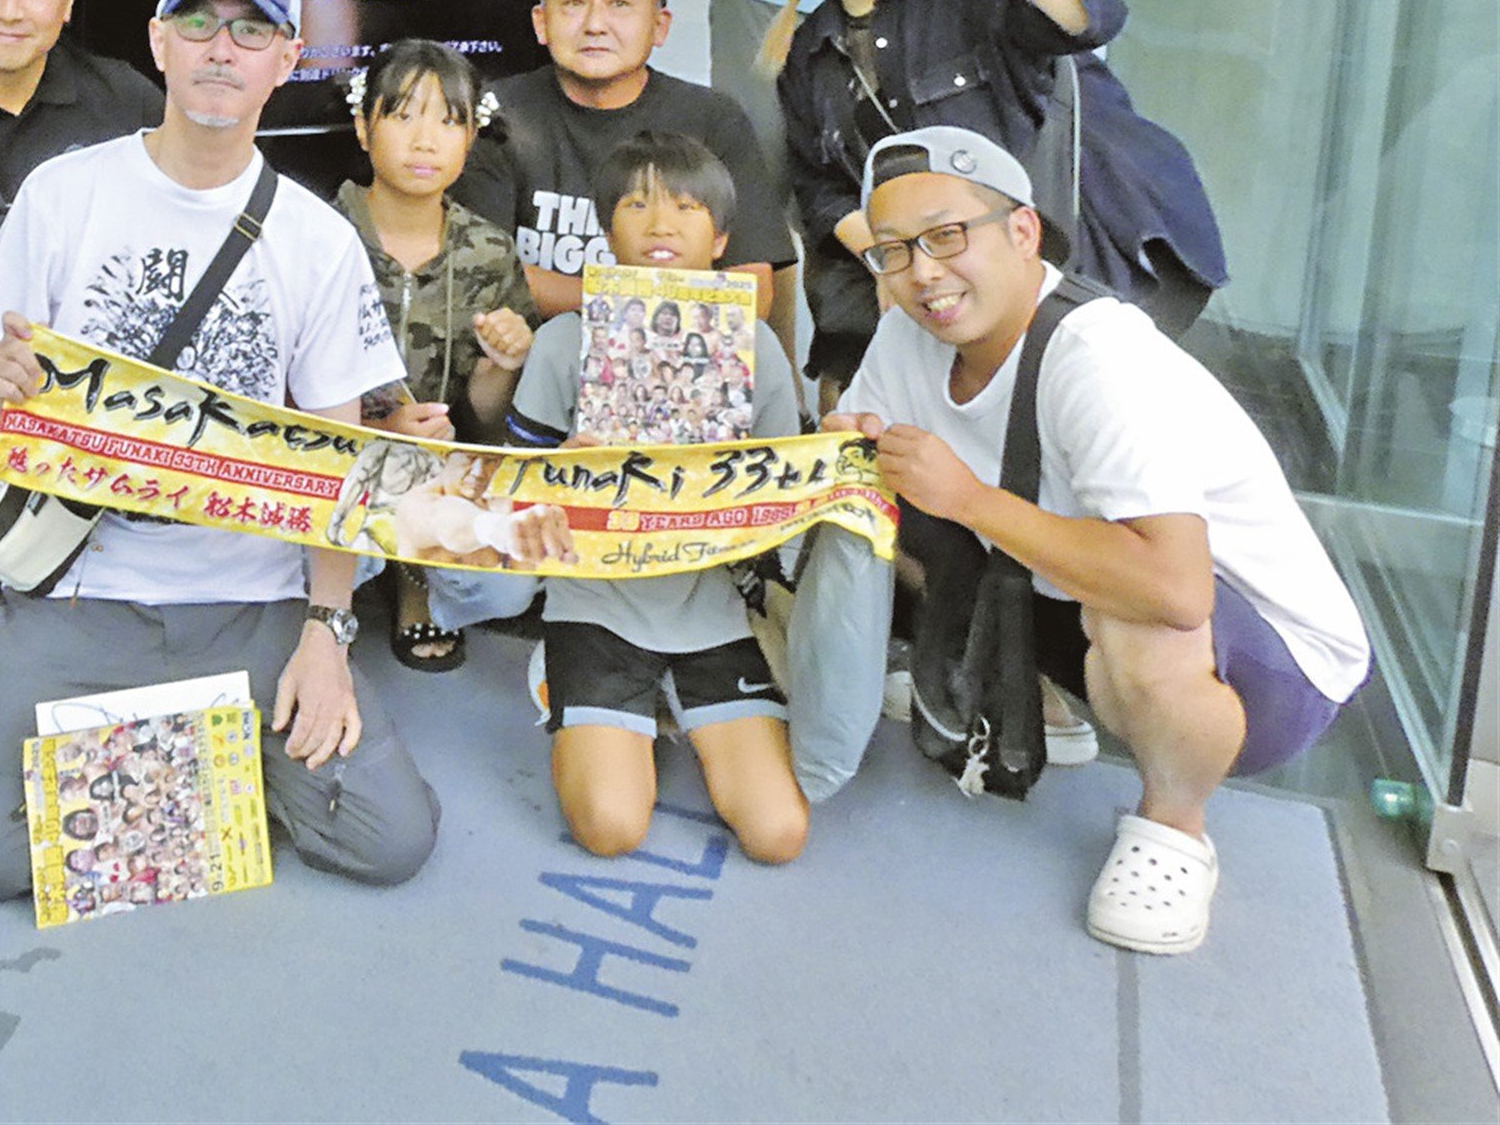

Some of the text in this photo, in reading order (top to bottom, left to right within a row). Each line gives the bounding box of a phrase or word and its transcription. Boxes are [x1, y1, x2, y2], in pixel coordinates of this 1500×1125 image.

[3, 412, 340, 498] MASAKATSU FUNAKI 33TH ANNIVERSARY
[706, 507, 748, 527] AGO
[602, 540, 681, 572] Hybrid
